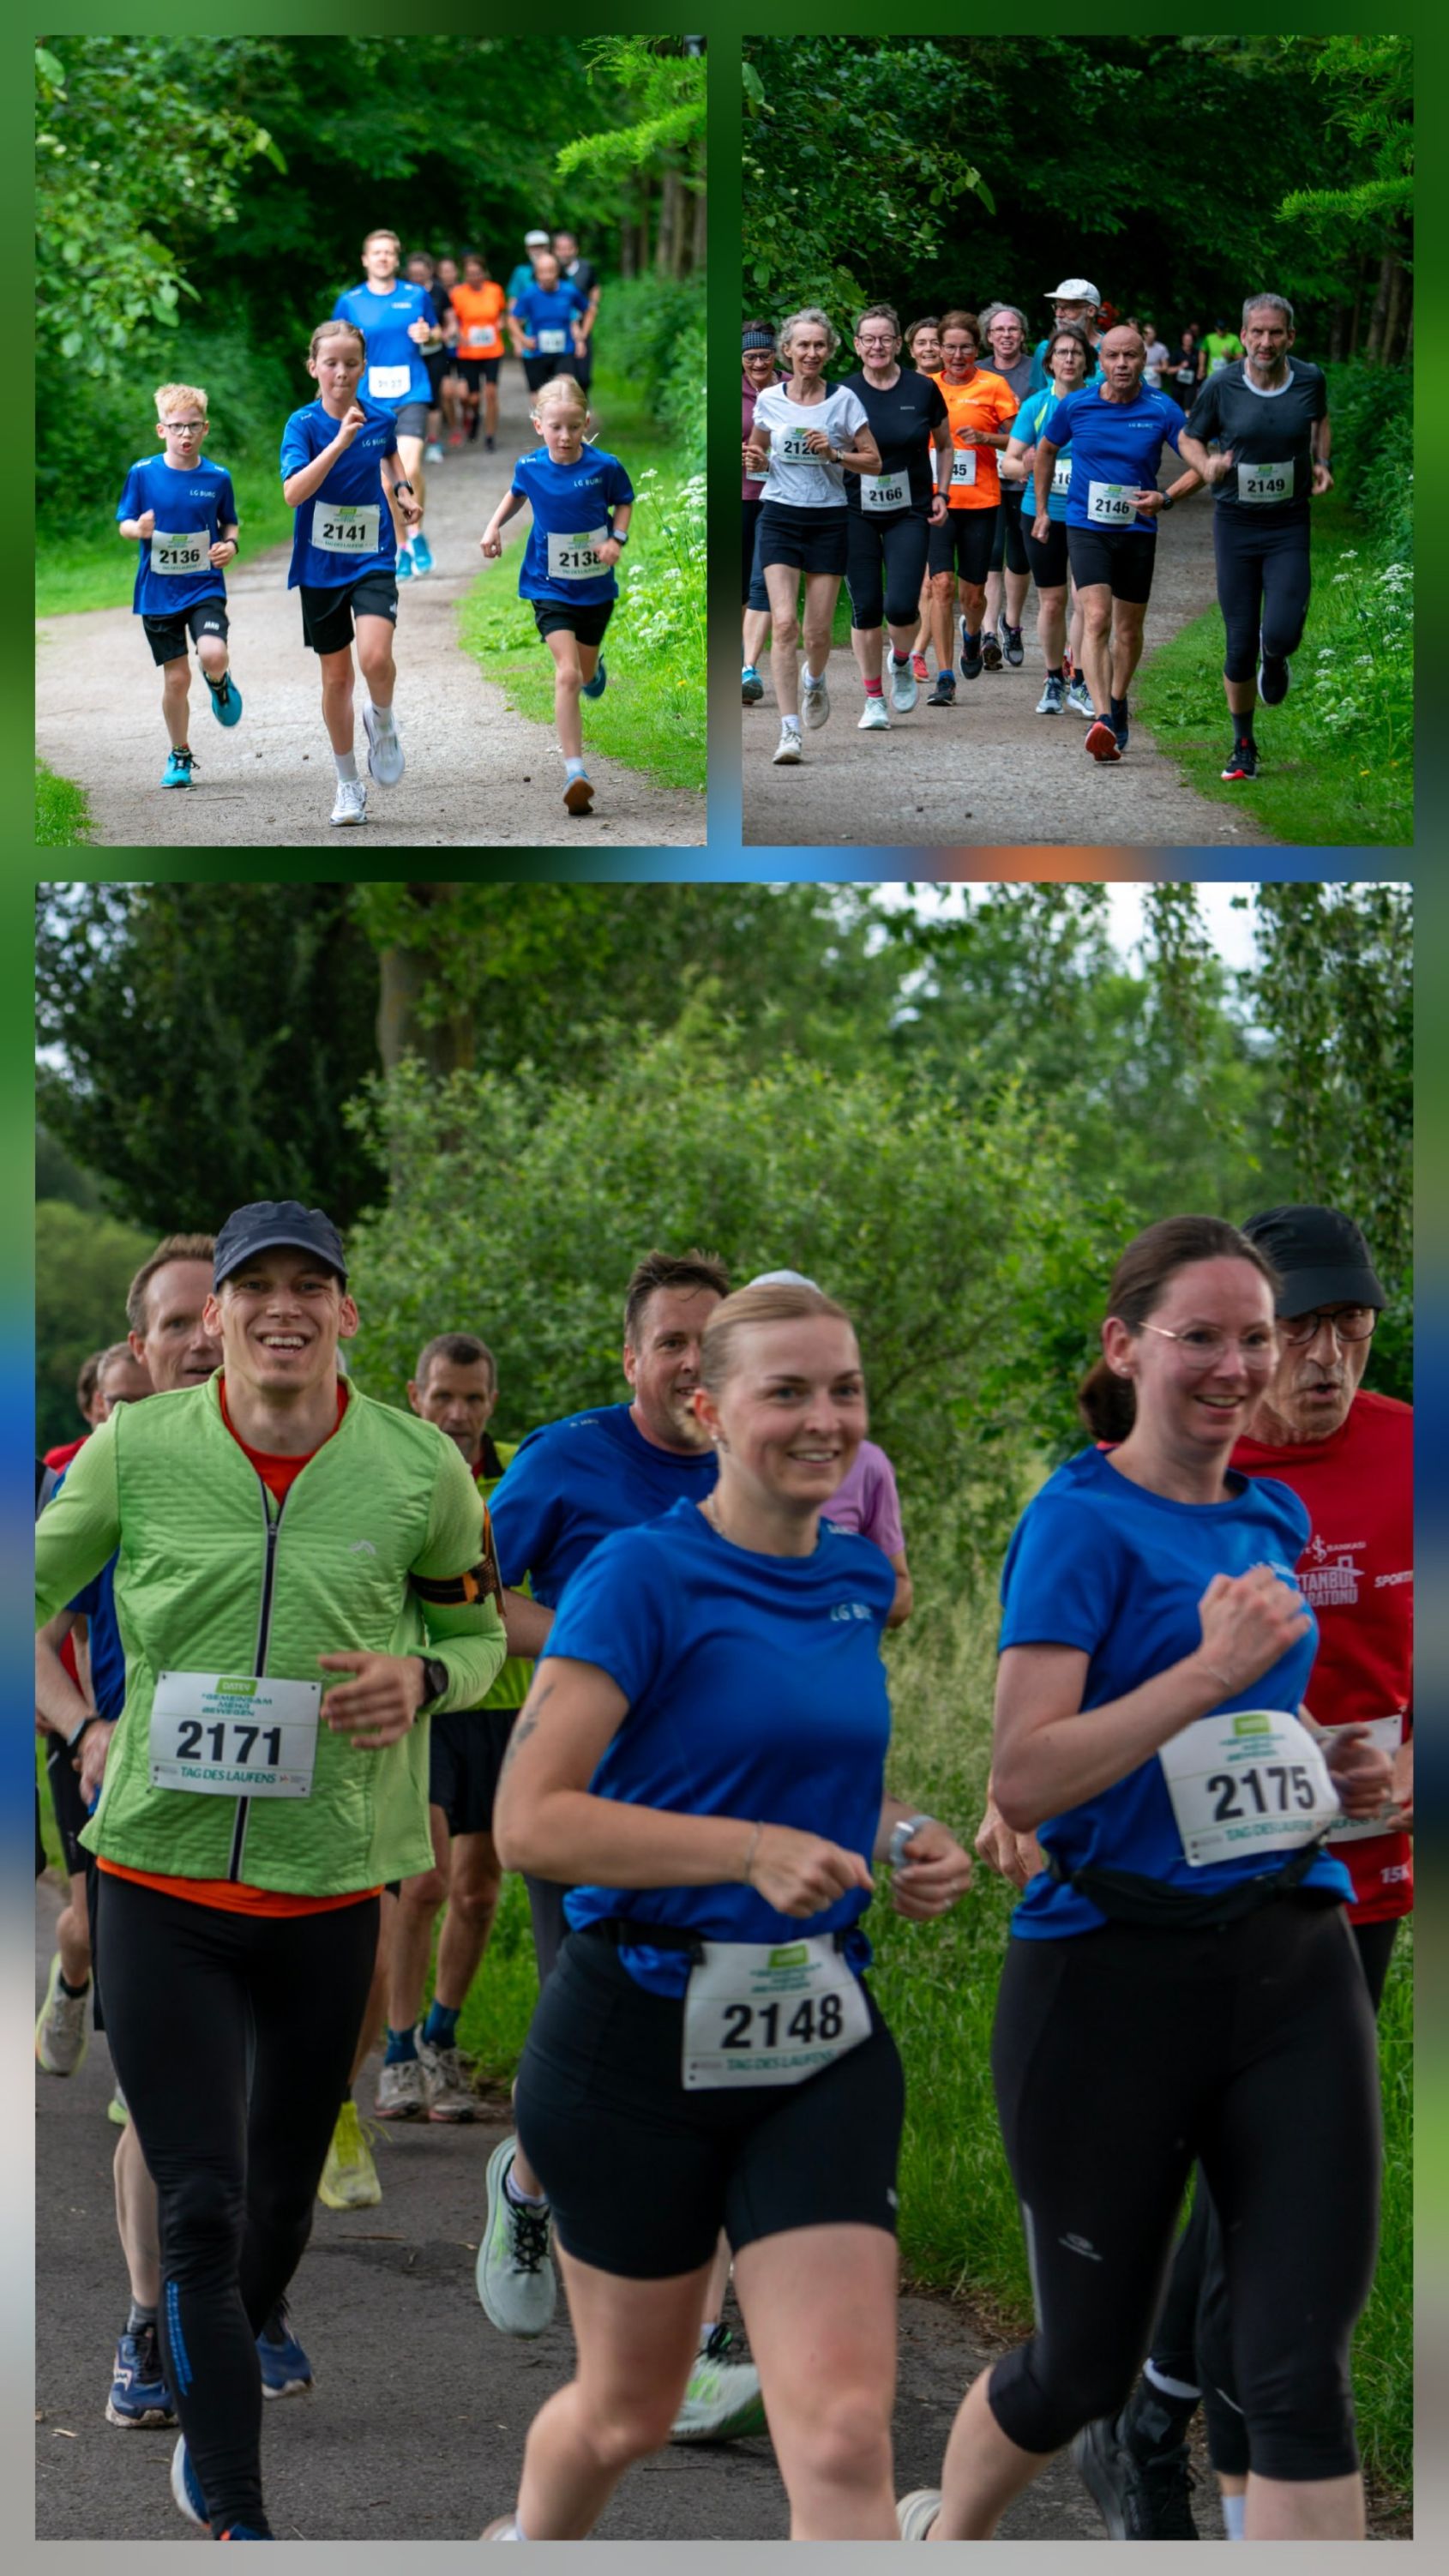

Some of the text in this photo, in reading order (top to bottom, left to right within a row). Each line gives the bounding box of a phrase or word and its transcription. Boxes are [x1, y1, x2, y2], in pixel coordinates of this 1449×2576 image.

[953, 464, 967, 476] 45
[869, 486, 903, 503] 2166
[1247, 478, 1285, 493] 2149
[1095, 498, 1130, 515] 2146
[322, 522, 366, 540] 2141
[159, 549, 201, 564] 2136
[1297, 1570, 1358, 1592] TANBUL
[1374, 1569, 1413, 1588] SPORT
[1306, 1587, 1359, 1608] RATONU
[176, 1719, 282, 1766] 2171
[181, 1766, 202, 1779] TAG
[202, 1768, 225, 1781] DES
[226, 1770, 277, 1784] LAUFENS
[1206, 1766, 1316, 1822] 2175
[720, 1993, 844, 2049] 2148
